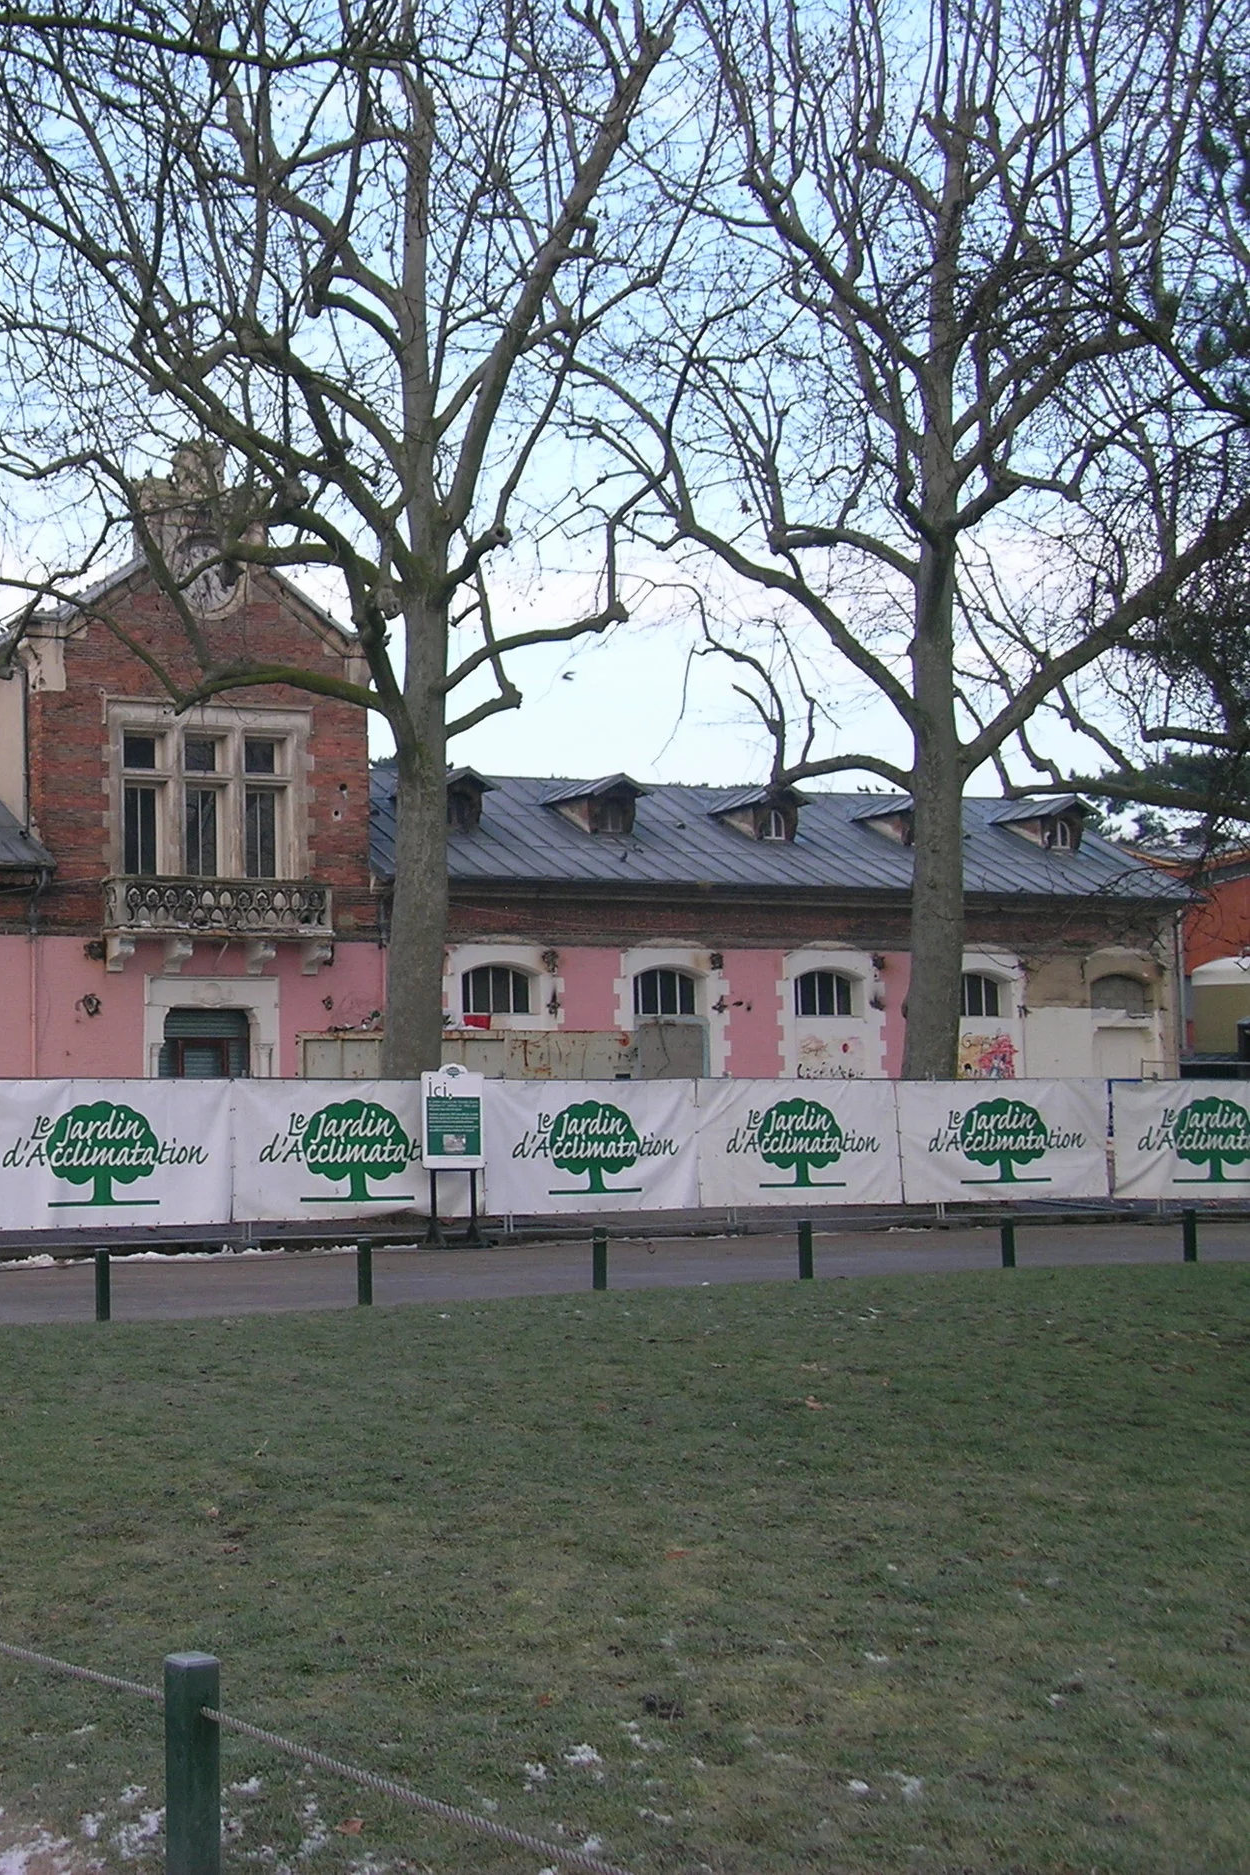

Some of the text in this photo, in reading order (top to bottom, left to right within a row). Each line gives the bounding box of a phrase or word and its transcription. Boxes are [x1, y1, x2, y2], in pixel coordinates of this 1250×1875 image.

[31, 1109, 145, 1147] Le Jardin
[288, 1107, 396, 1145] Le Jardin
[537, 1108, 627, 1140] Le Jardin
[746, 1104, 832, 1136] Le Jardin
[948, 1104, 1037, 1135] Le Jardin
[1161, 1103, 1247, 1133] Le Jardin
[2, 1137, 209, 1168] d'Acclimatation
[259, 1133, 422, 1163] d'Acclimatat
[512, 1131, 679, 1159] d'Acclimatation
[726, 1127, 880, 1153] d'Acclimatation
[928, 1126, 1086, 1152] d'Acclimatation
[1137, 1126, 1250, 1150] d'Acclimat
